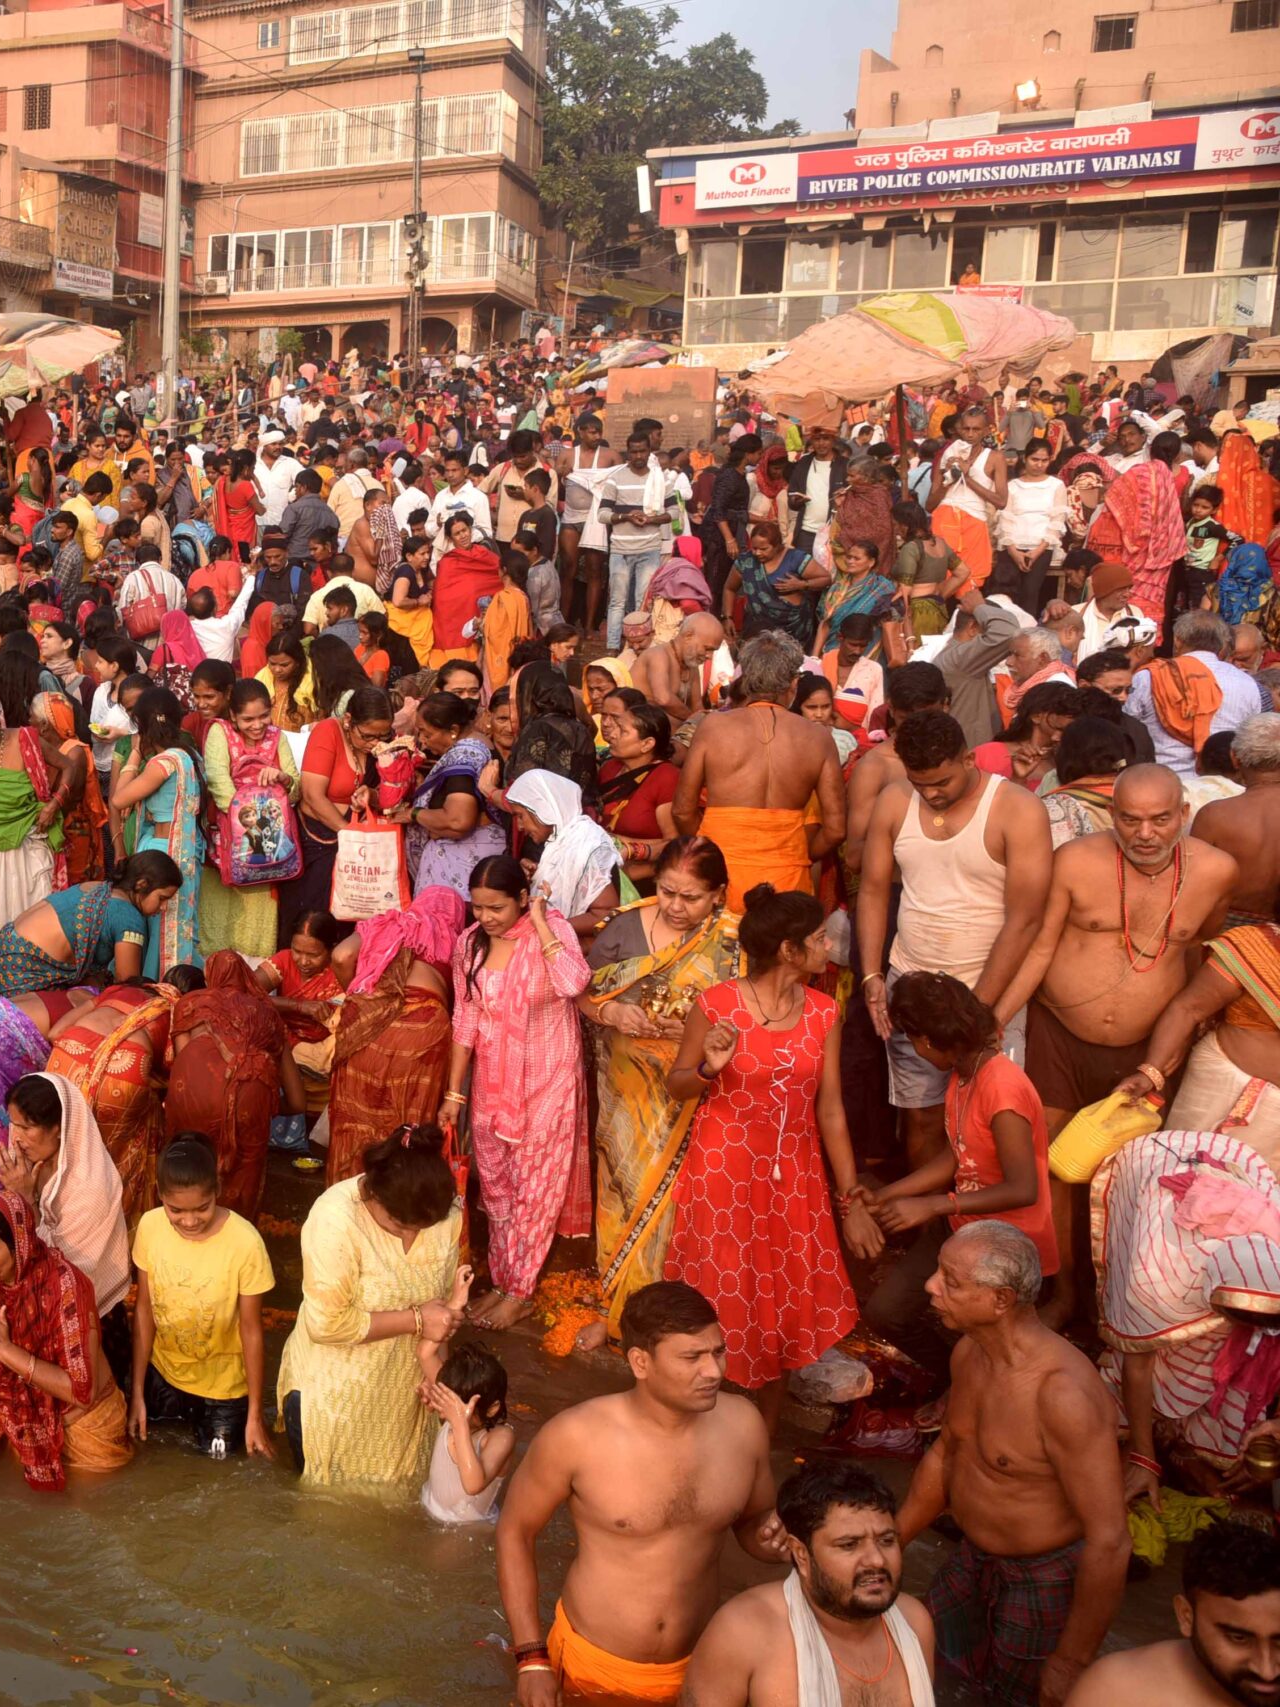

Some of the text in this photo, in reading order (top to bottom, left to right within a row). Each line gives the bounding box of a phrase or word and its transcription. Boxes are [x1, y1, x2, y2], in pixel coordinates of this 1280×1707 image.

[854, 126, 1131, 169] जल पुलिस कमिश्नरेट वाराणसी
[809, 149, 1182, 195] RIVER POLICE COMMISSIONERATE VARANASI
[705, 186, 791, 201] Muthoot Finance
[344, 864, 380, 876] CHETAN
